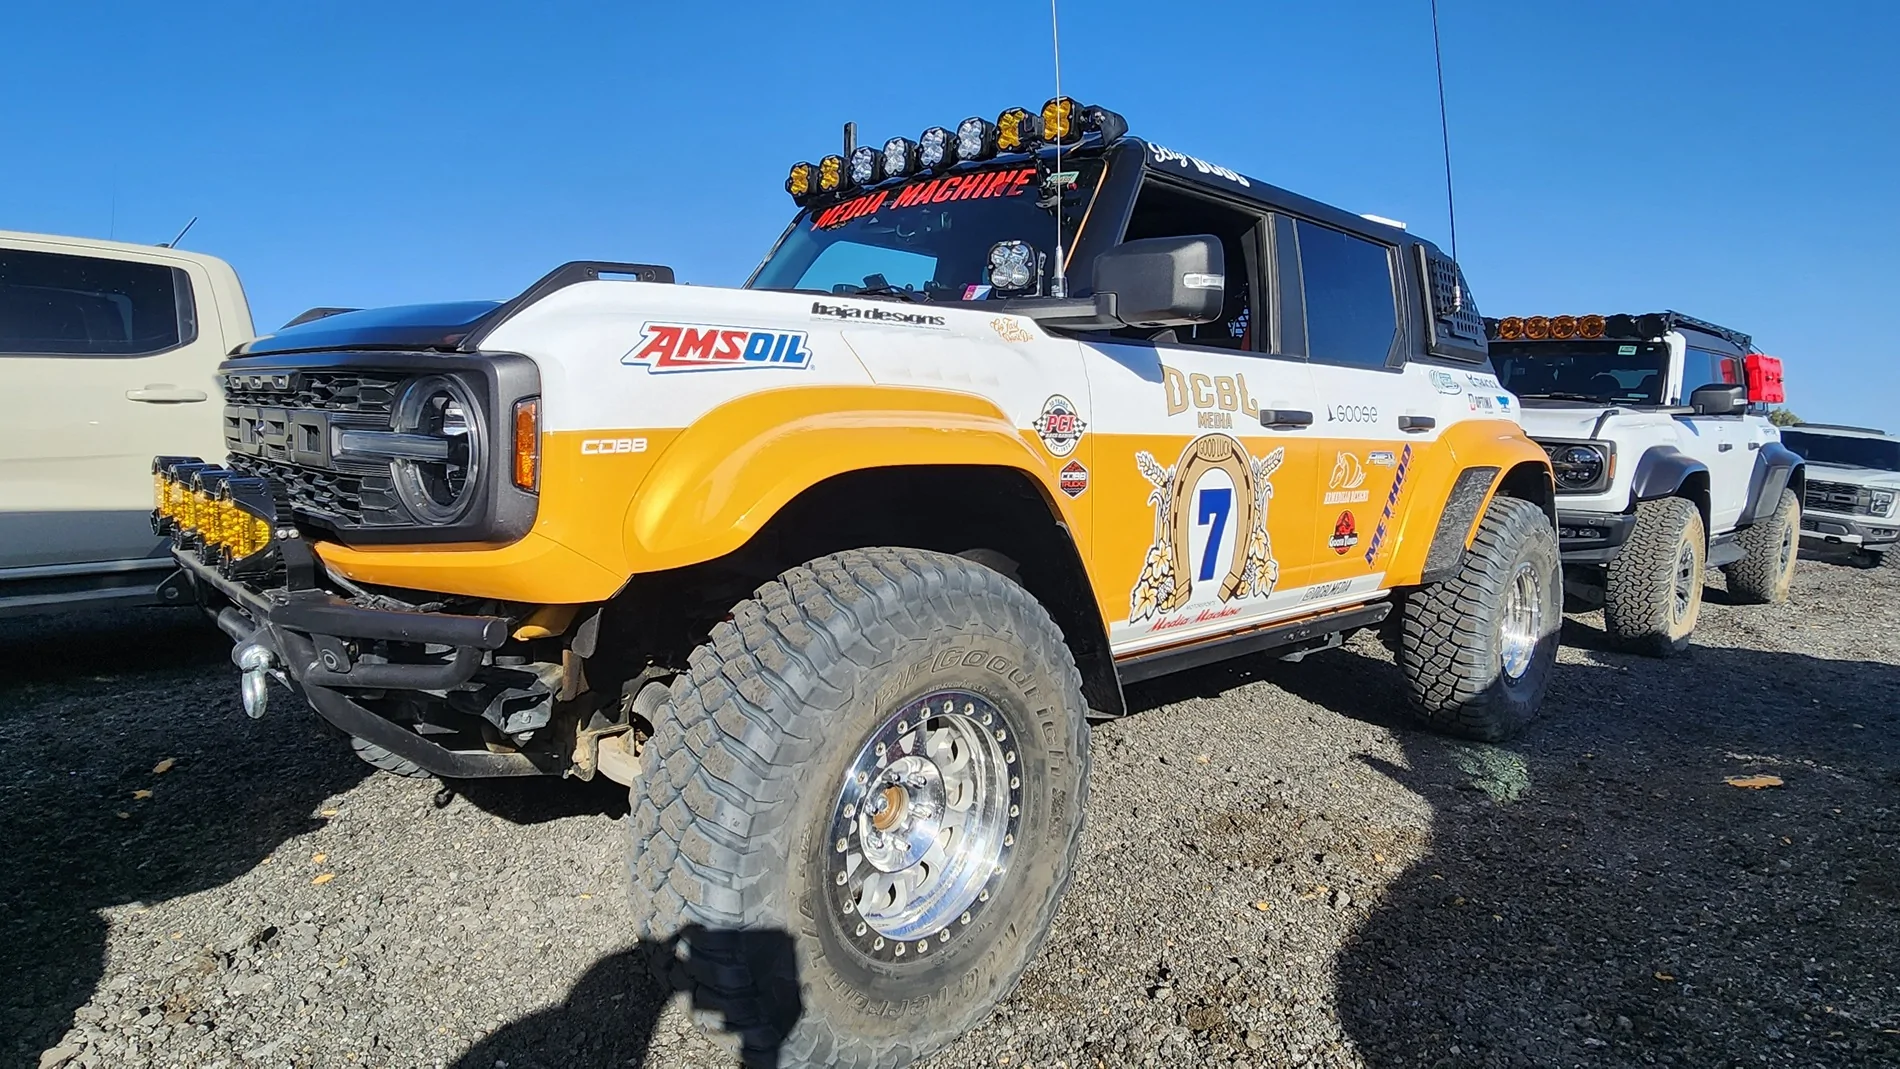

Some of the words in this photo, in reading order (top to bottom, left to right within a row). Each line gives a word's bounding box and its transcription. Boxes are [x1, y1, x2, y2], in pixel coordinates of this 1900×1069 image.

[810, 190, 888, 232] MEDIA
[890, 168, 1038, 210] MACHINE
[811, 301, 861, 319] baja
[864, 307, 946, 326] designs
[634, 325, 808, 368] AMSOIL
[1161, 364, 1259, 420] DCBL
[1045, 415, 1076, 433] PCI
[1197, 411, 1233, 430] MEDIA
[581, 438, 648, 455] COBB
[1199, 438, 1217, 458] GOOD
[1365, 443, 1412, 565] METHOD
[1198, 488, 1232, 582] 7
[1146, 614, 1188, 633] Media
[1190, 606, 1242, 625] Machine
[873, 646, 1066, 778] BFGoodrich
